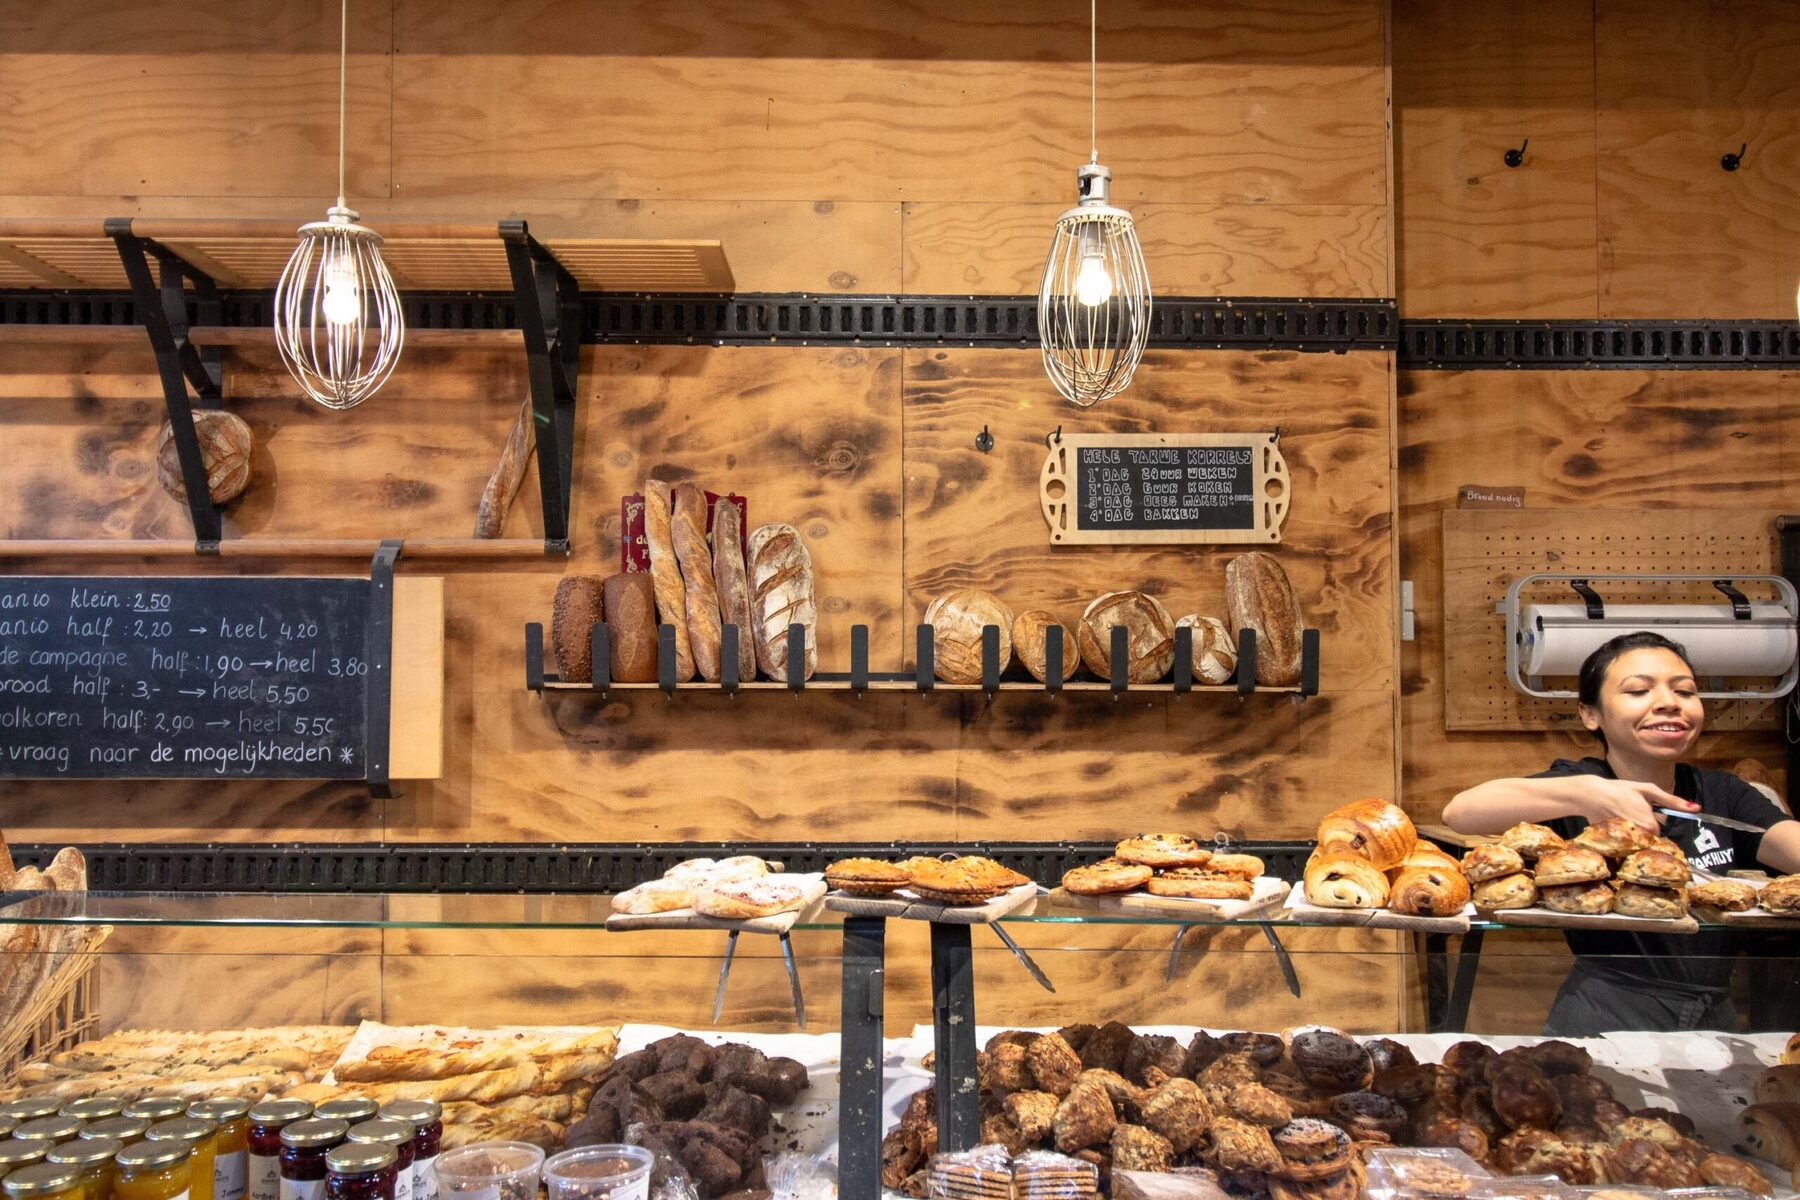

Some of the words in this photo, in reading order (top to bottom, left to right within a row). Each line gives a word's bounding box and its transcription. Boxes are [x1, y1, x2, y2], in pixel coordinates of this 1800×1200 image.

[1083, 449, 1121, 464] HELE
[1128, 449, 1181, 464] TARWE
[1187, 449, 1252, 465] KORRELS
[1102, 468, 1130, 482] DAG
[1187, 467, 1238, 480] WEKEN
[1102, 482, 1132, 496] DAG
[1187, 481, 1233, 494] KOKEN
[1103, 495, 1133, 508] DAG
[1496, 494, 1521, 508] nodig
[1104, 507, 1134, 522] DAG
[1143, 507, 1199, 520] BAKKEN
[220, 616, 268, 639] heel
[280, 622, 318, 641] 4,20
[29, 650, 127, 678] campagne
[275, 648, 316, 673] heel
[327, 657, 368, 678] 3,80
[212, 679, 257, 701] heel
[266, 685, 309, 704] 5,50
[238, 710, 281, 733] heel
[9, 746, 69, 772] vraag
[90, 747, 140, 763] naar
[150, 741, 174, 763] de
[184, 740, 332, 774] mogelijkheden
